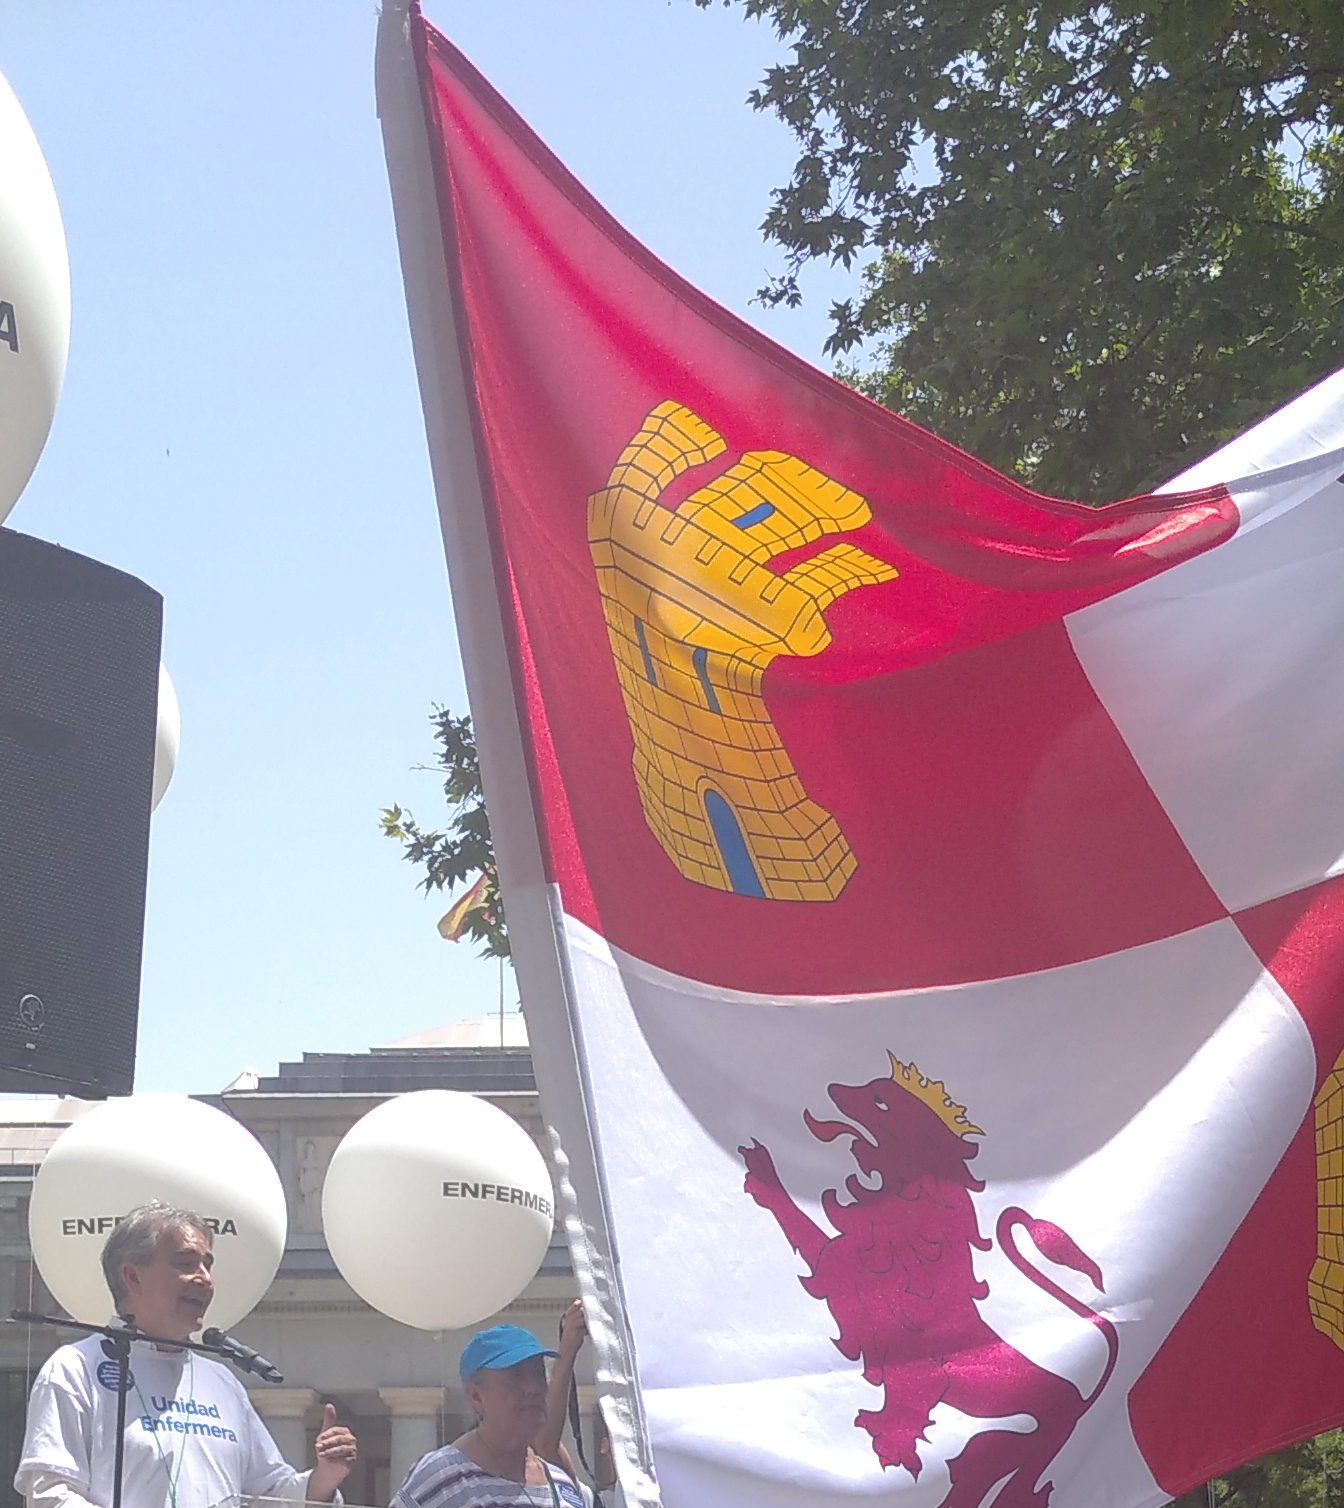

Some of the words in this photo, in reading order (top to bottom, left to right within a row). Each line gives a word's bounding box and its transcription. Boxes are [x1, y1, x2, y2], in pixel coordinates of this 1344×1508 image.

[442, 1181, 553, 1219] ENFERMER
[150, 1395, 222, 1420] Unidad
[139, 1413, 239, 1444] Enfermera
